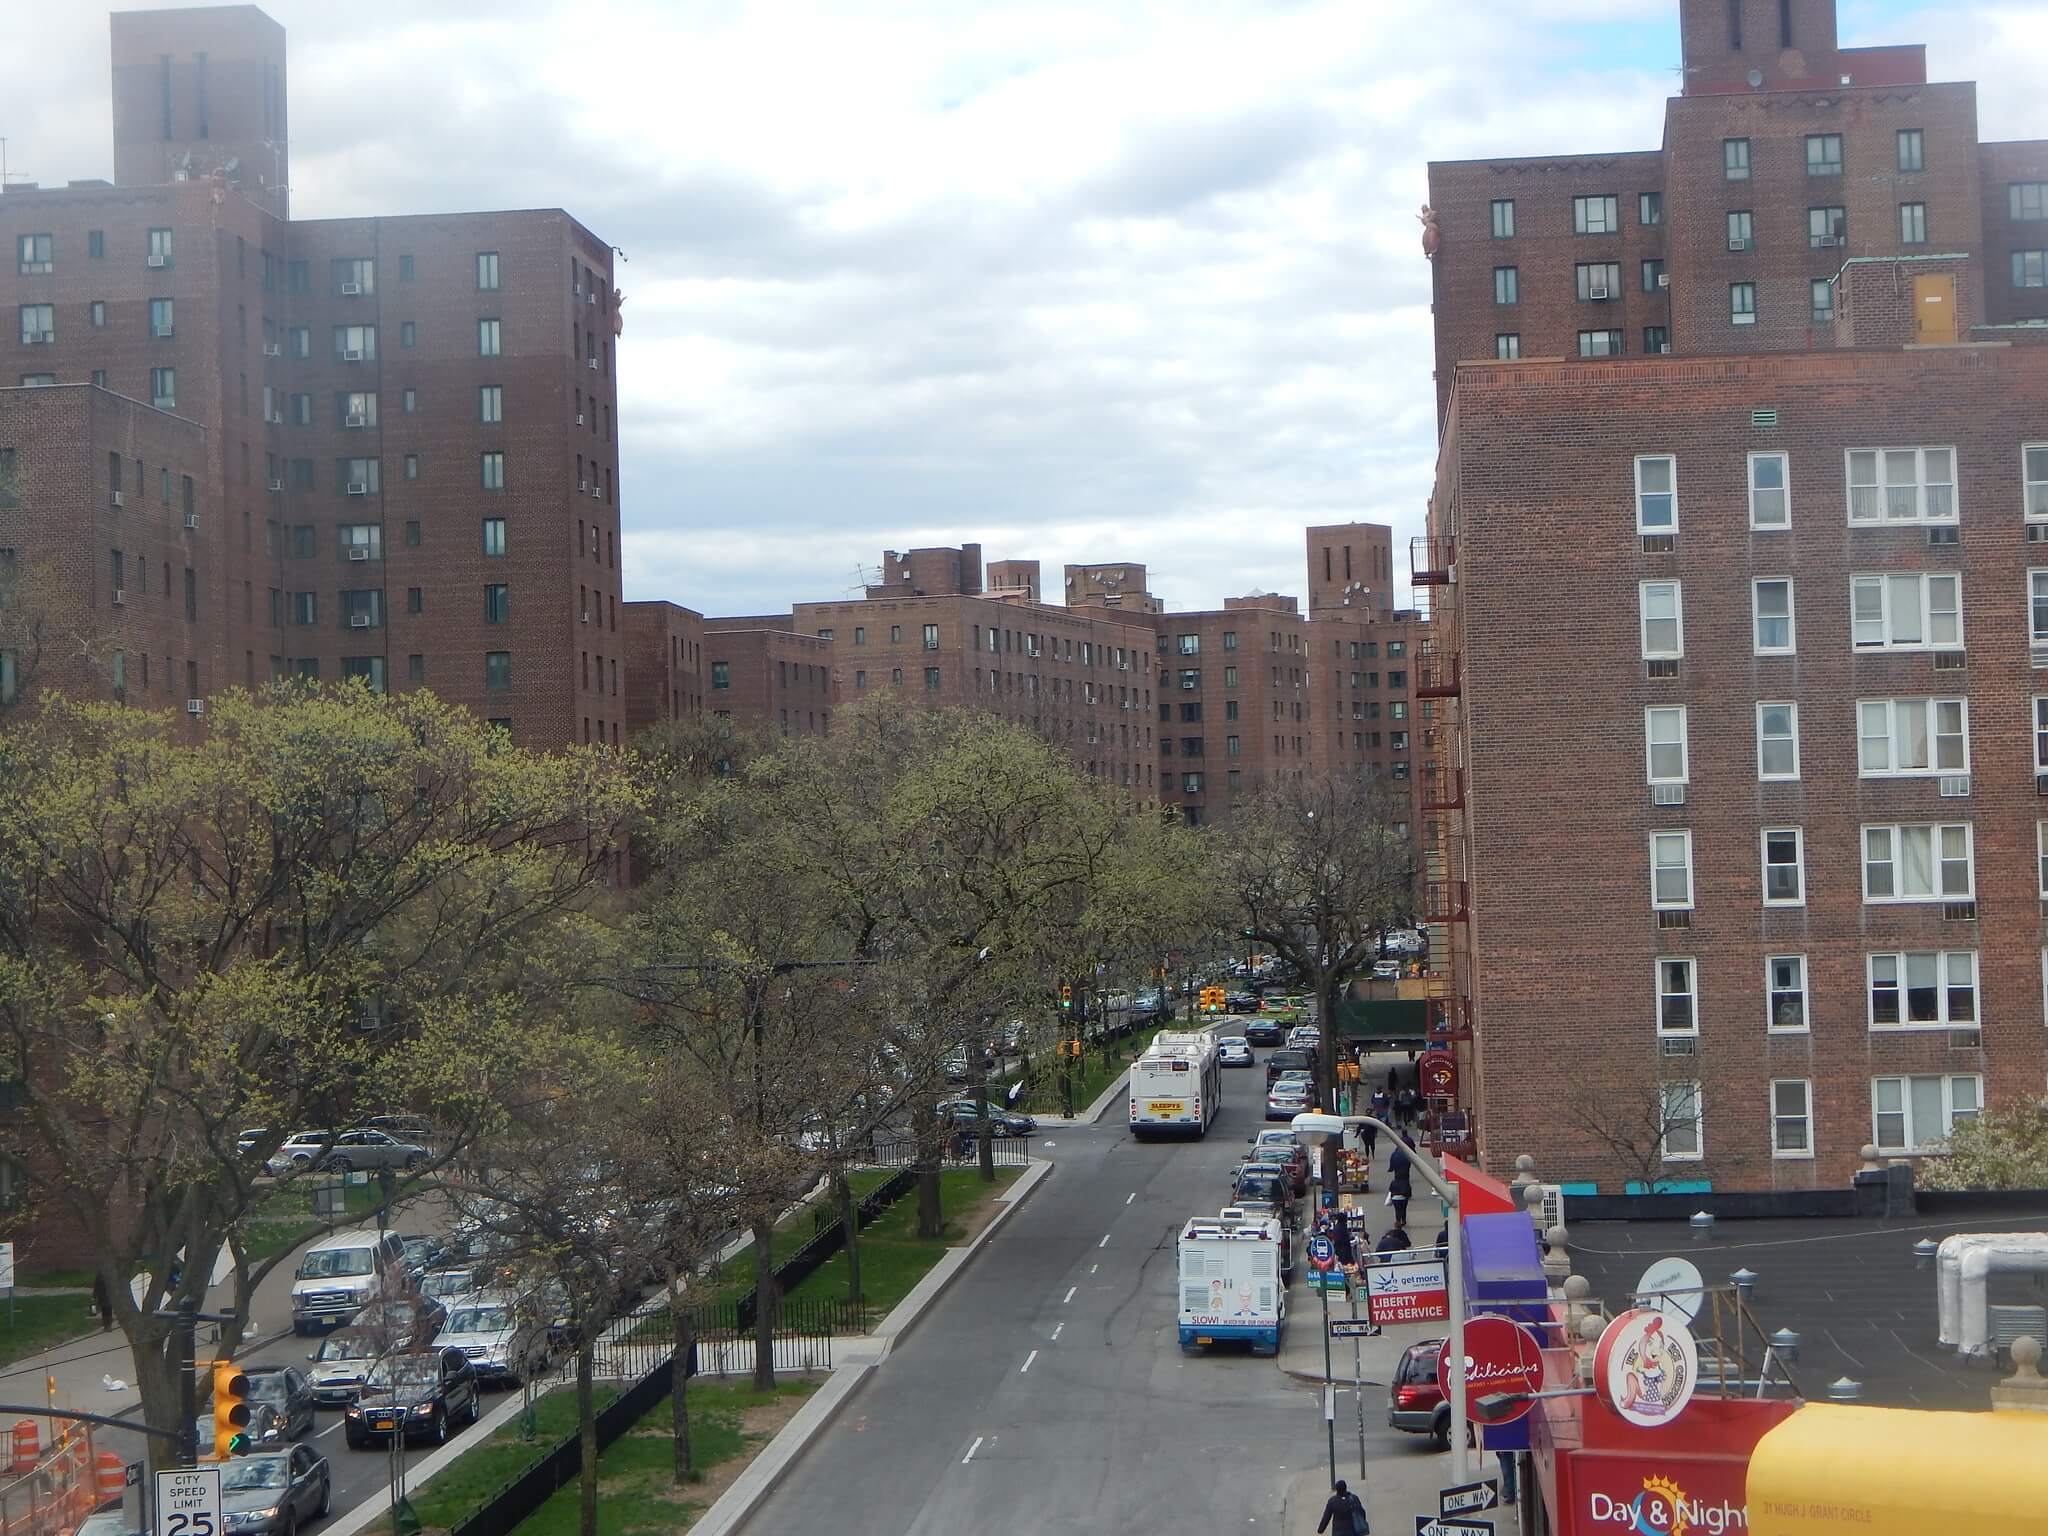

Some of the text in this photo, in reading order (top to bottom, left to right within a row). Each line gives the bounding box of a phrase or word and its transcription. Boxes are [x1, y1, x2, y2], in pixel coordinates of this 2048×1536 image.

[1401, 1276, 1415, 1285] get
[1416, 1275, 1440, 1284] more
[1373, 1296, 1417, 1308] LIBERTY
[1373, 1306, 1444, 1321] TAX SERVICE
[175, 1475, 201, 1485] CITY
[169, 1487, 207, 1497] SPEED
[174, 1499, 203, 1509] LIMIT
[1448, 1489, 1490, 1509] ONE WAY
[1591, 1493, 1642, 1530] Day
[1649, 1500, 1668, 1525] &
[1774, 1503, 1799, 1517] HUGH
[1809, 1504, 1840, 1520] GRANT
[1840, 1506, 1872, 1523] CIRCLE
[167, 1511, 214, 1536] 25
[1428, 1526, 1484, 1536] ONE WAY
